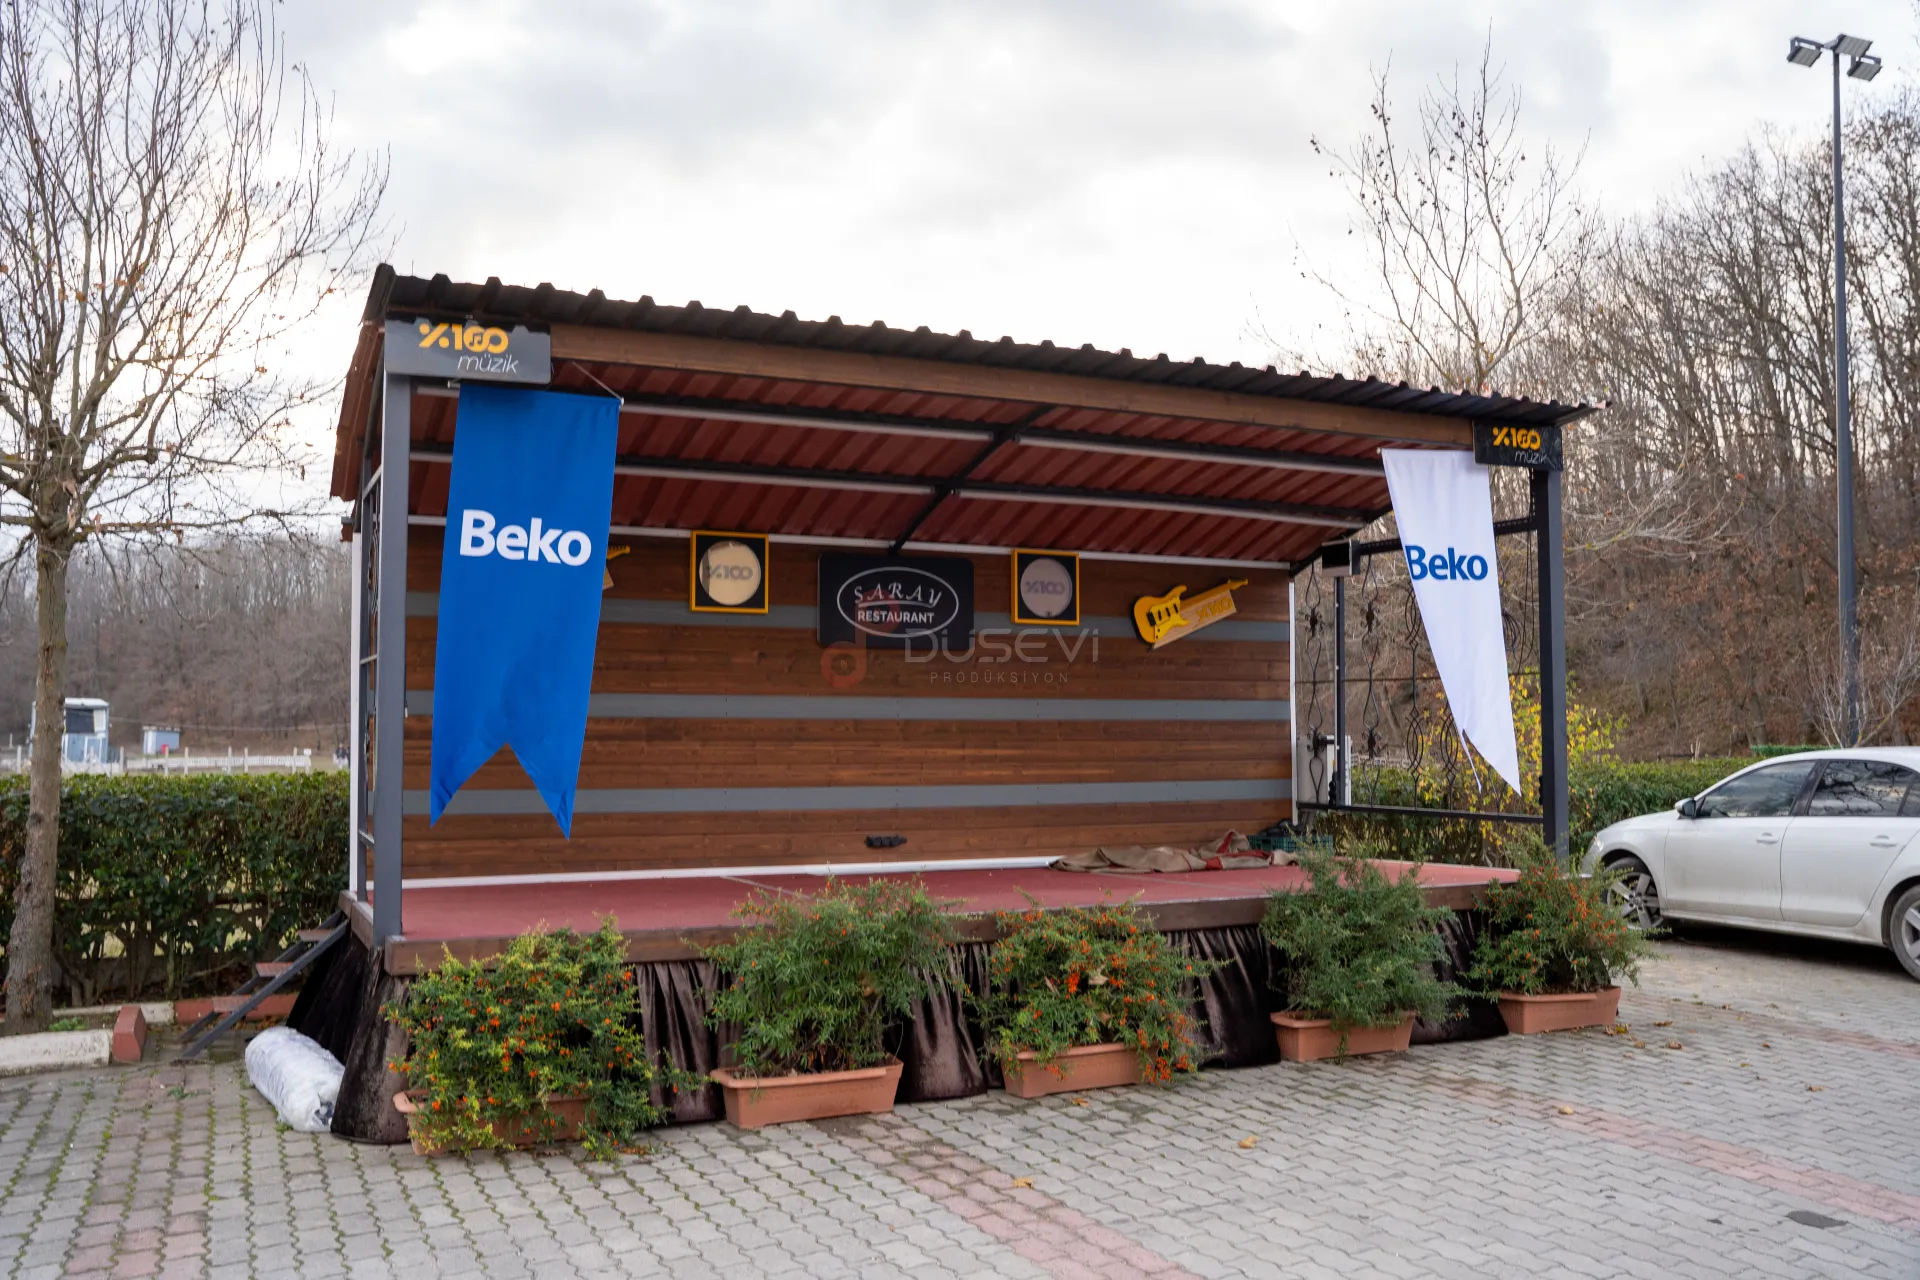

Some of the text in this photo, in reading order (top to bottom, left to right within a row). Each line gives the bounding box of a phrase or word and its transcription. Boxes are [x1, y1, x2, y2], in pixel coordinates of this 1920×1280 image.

[418, 323, 509, 354] %100
[457, 353, 520, 374] müzik
[1492, 426, 1541, 451] %100
[1514, 450, 1549, 465] müzik
[459, 508, 592, 567] Beko
[1405, 544, 1489, 581] Beko
[854, 581, 942, 607] SARAY
[857, 609, 935, 624] RESTAURANT
